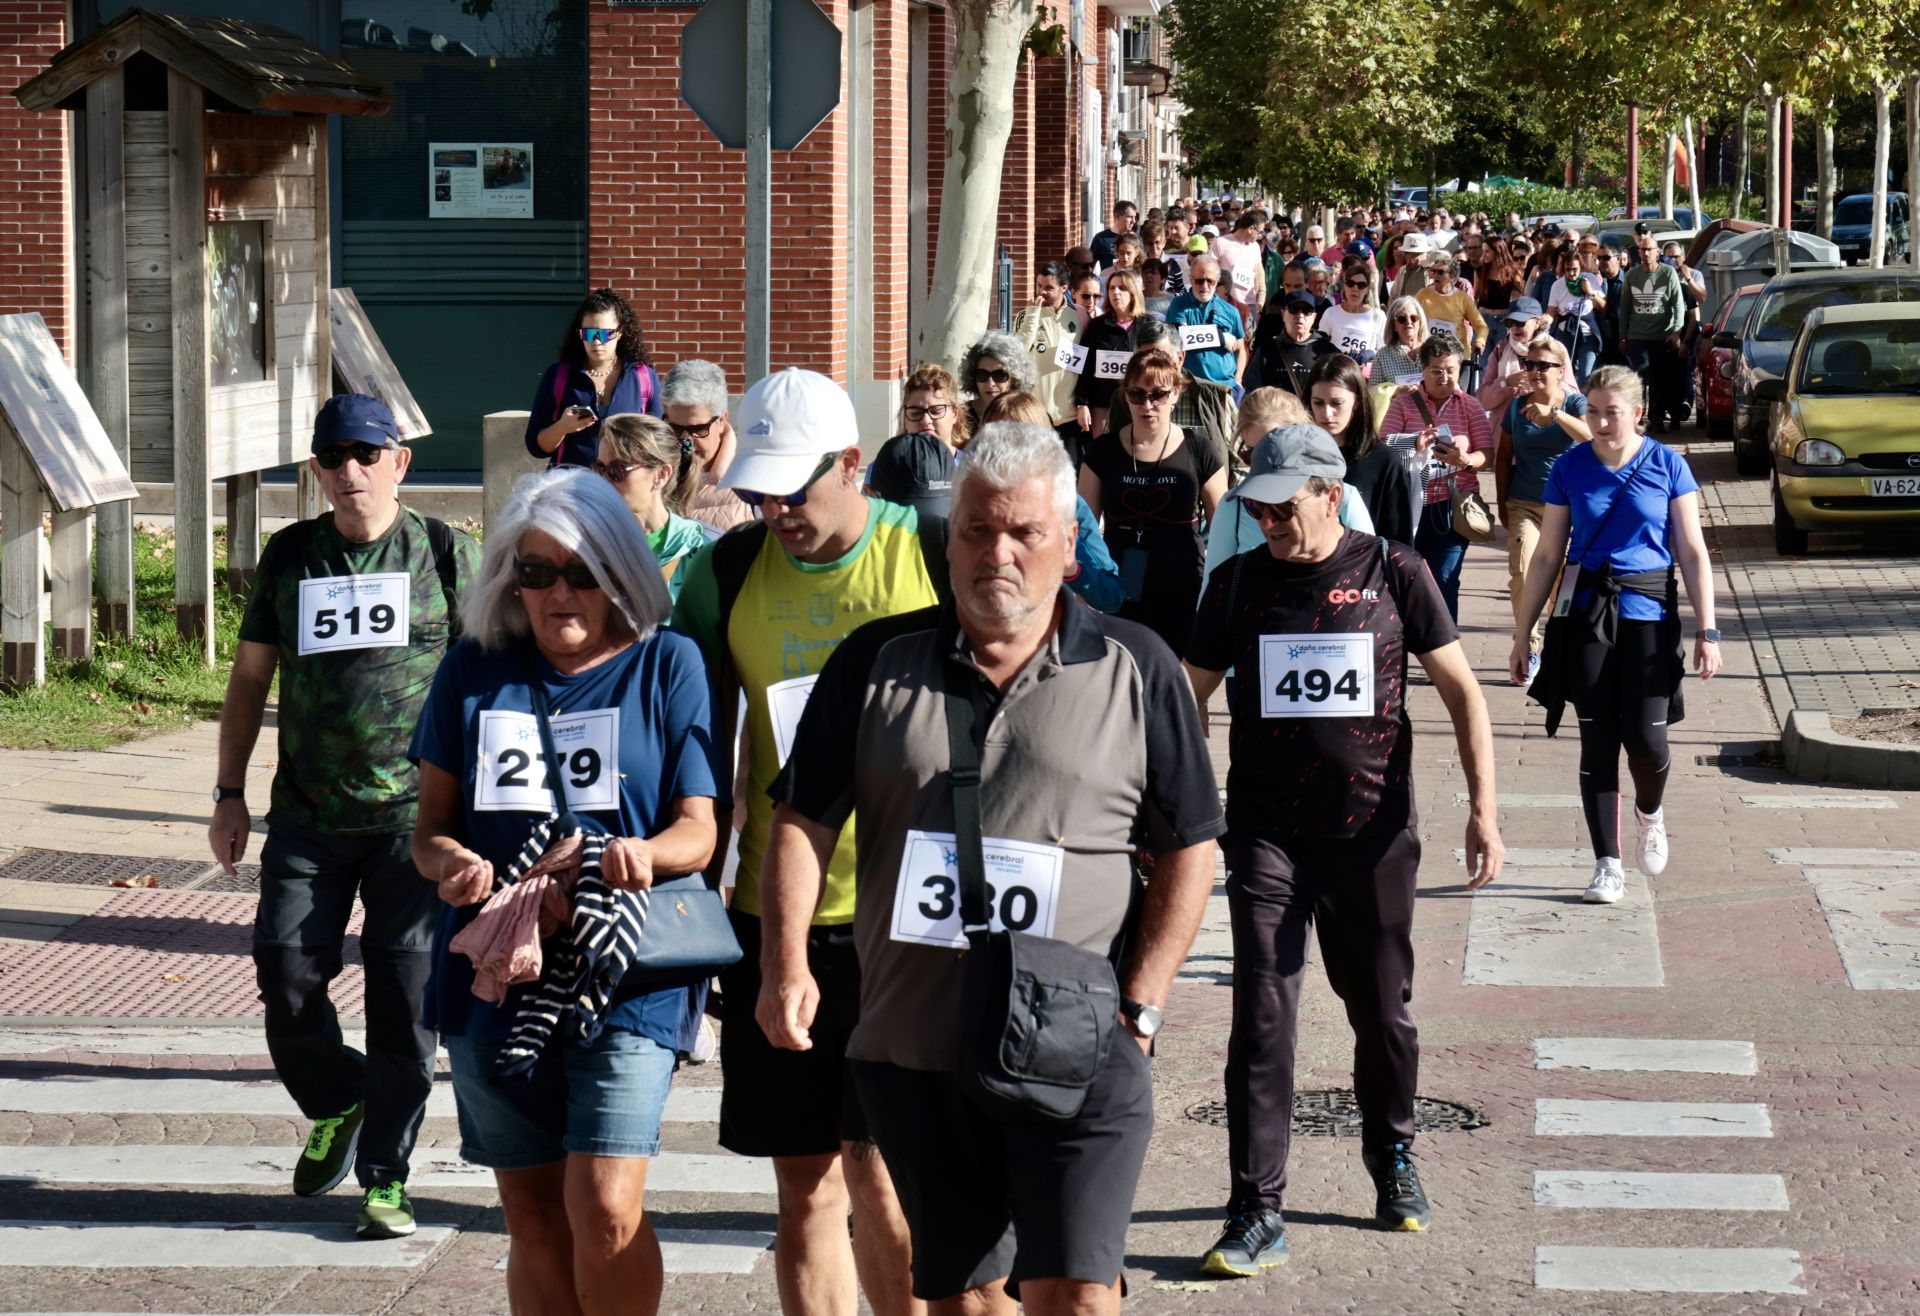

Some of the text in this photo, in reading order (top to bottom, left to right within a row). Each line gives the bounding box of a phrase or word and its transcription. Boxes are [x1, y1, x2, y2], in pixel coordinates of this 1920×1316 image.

[1235, 272, 1251, 285] 105
[1186, 333, 1214, 344] 269
[1341, 336, 1367, 351] 266
[1059, 350, 1081, 367] 397
[1101, 361, 1128, 374] 396
[1122, 475, 1177, 485] MORE OVE
[313, 603, 396, 640] 519
[1275, 668, 1361, 702] 494
[553, 723, 586, 735] cerebral
[985, 852, 1024, 865] cerebral
[918, 874, 1038, 931] 30
